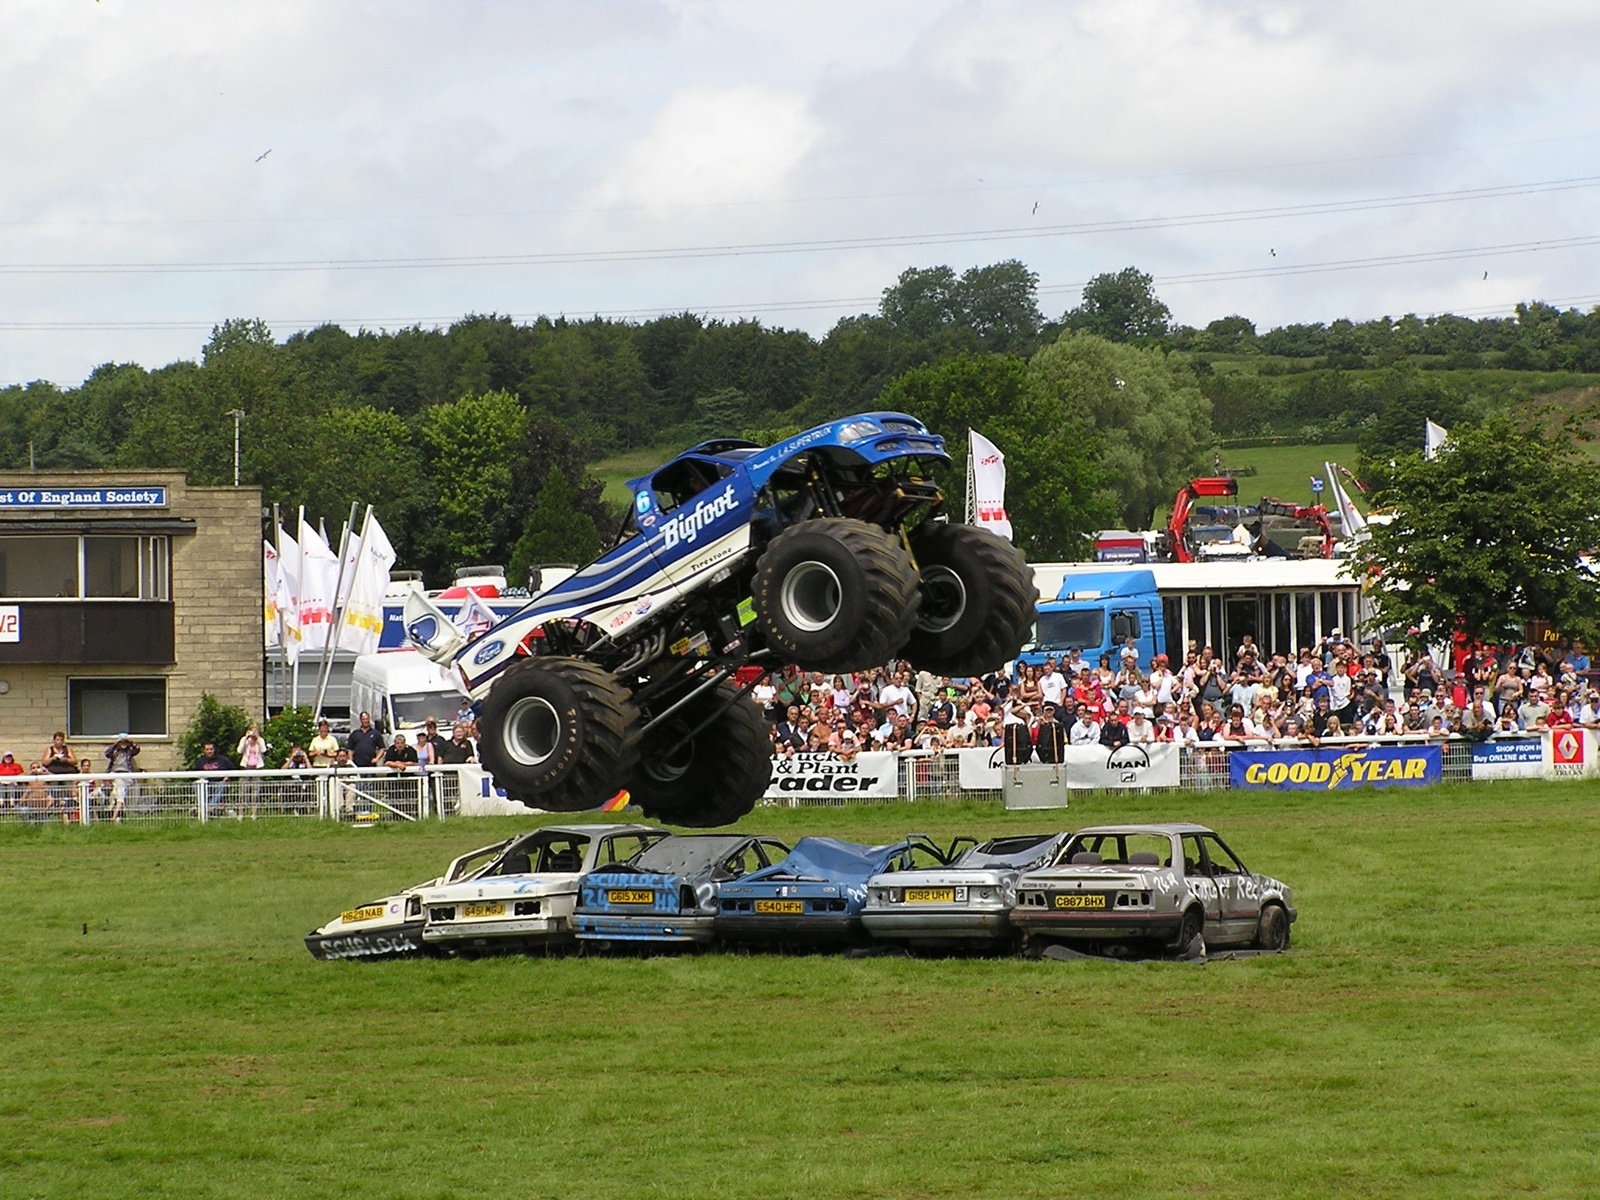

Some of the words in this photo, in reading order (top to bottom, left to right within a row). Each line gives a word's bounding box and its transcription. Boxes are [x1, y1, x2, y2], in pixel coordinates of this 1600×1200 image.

[18, 491, 35, 503] Of
[41, 491, 101, 505] England
[106, 491, 159, 504] Society
[636, 491, 651, 514] 6
[659, 484, 739, 550] Bigfoot
[691, 547, 732, 571] Firestone
[1111, 761, 1146, 769] MAN
[1473, 755, 1488, 763] Buy
[1489, 754, 1517, 762] ONLINE
[776, 760, 792, 774] &
[797, 761, 858, 774] Plant
[1245, 762, 1331, 784] GOOD
[1351, 758, 1427, 781] YEAR
[586, 873, 679, 889] SCURLOCK
[611, 892, 630, 901] G615
[632, 891, 650, 901] XMH
[908, 890, 930, 900] G192
[931, 889, 952, 900] UHY
[1056, 896, 1081, 906] C887
[1084, 895, 1105, 906] BHX
[342, 910, 364, 921] H629
[365, 907, 383, 917] NAB
[756, 902, 782, 912] E540
[783, 902, 802, 912] HFH
